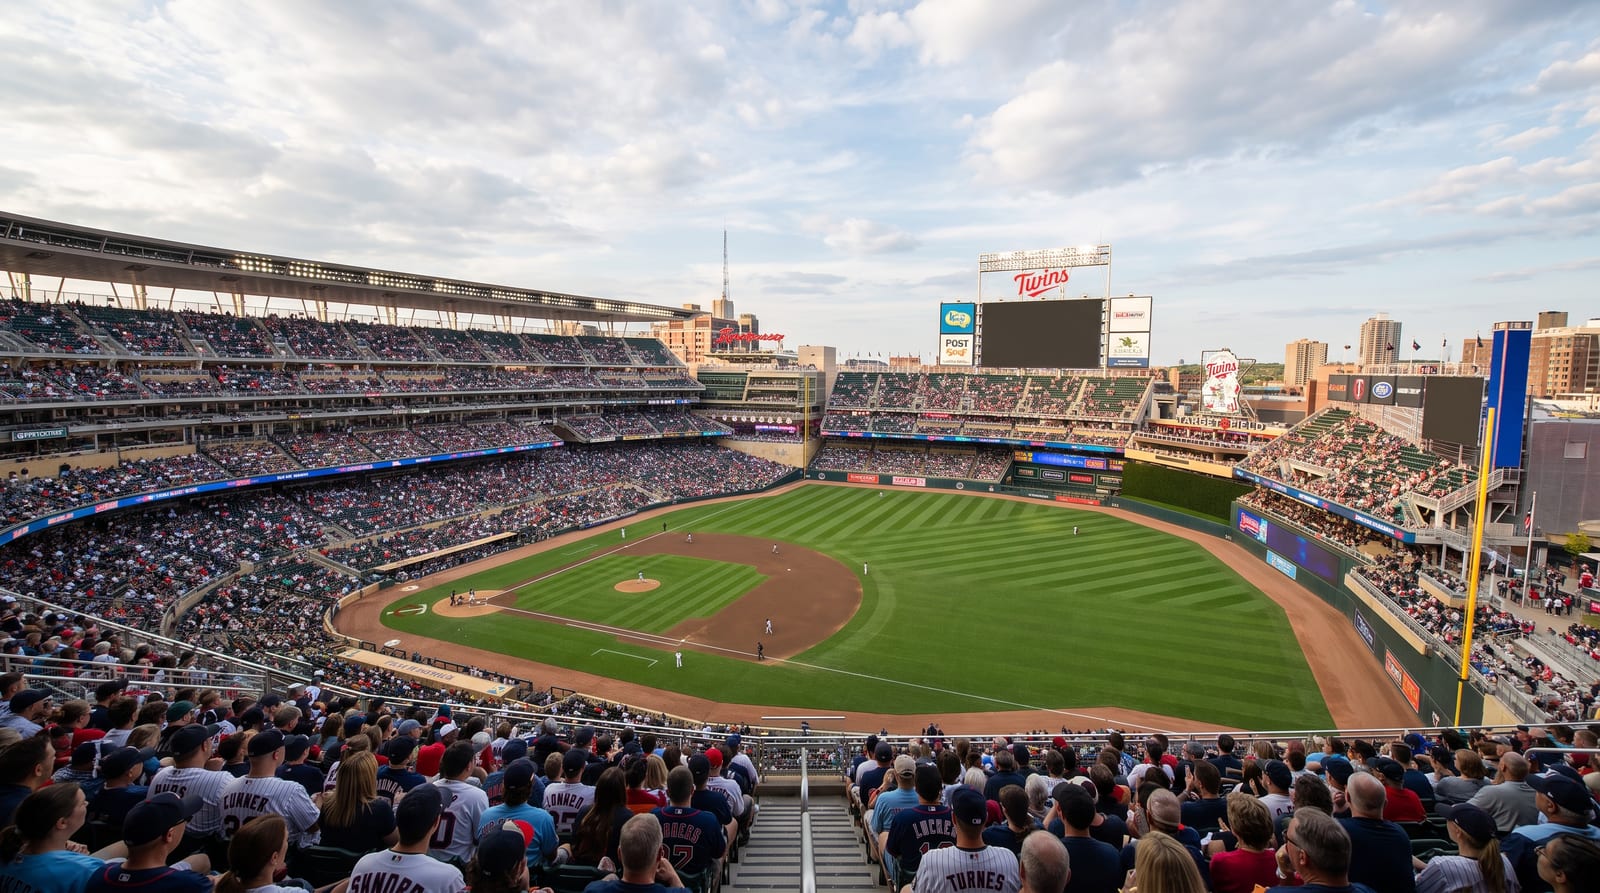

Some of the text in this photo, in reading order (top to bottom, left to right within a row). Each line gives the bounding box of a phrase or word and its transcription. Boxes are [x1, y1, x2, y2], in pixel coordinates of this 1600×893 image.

[1014, 268, 1068, 297] Twins
[945, 339, 969, 347] POST
[1206, 361, 1237, 379] Twins
[1177, 415, 1265, 430] TARGET FIELD
